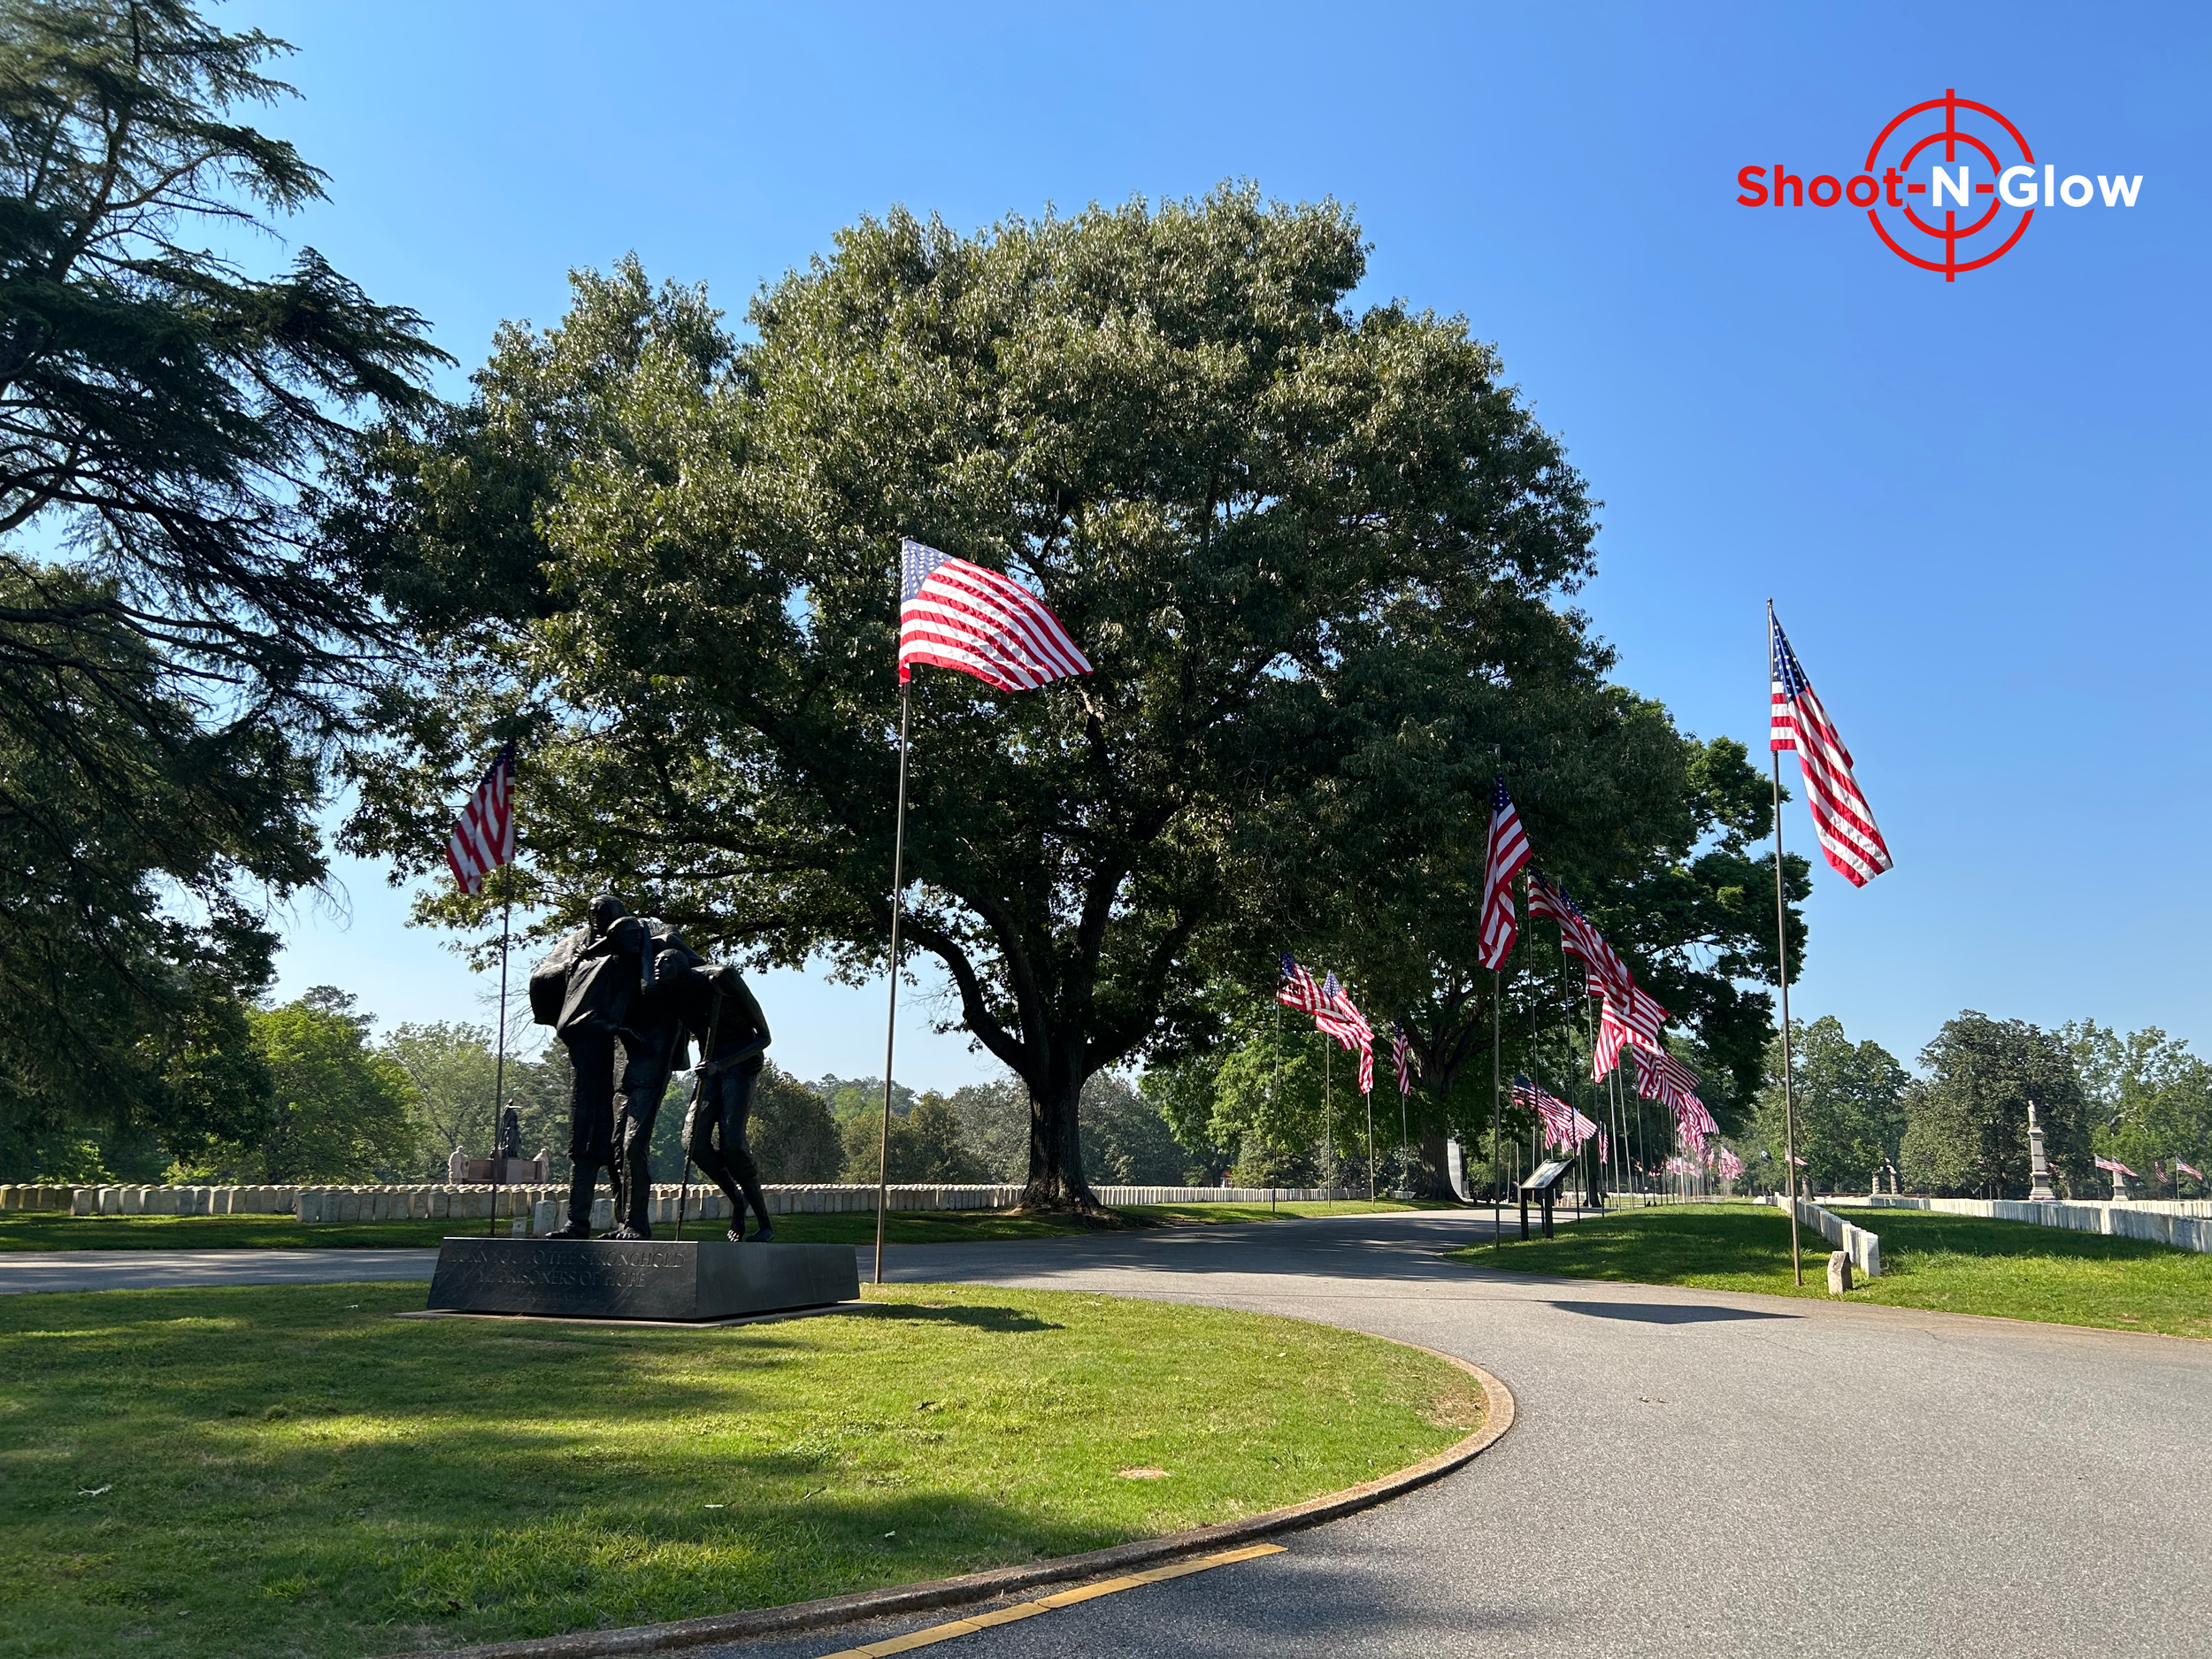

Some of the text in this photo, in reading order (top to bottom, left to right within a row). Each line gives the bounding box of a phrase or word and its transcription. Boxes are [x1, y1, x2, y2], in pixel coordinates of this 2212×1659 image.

[548, 1250, 577, 1265] THE
[580, 1251, 686, 1268] STRONGHOLD
[496, 1269, 577, 1286] PRISONERS
[580, 1271, 602, 1286] OF
[604, 1271, 647, 1287] HOPE
